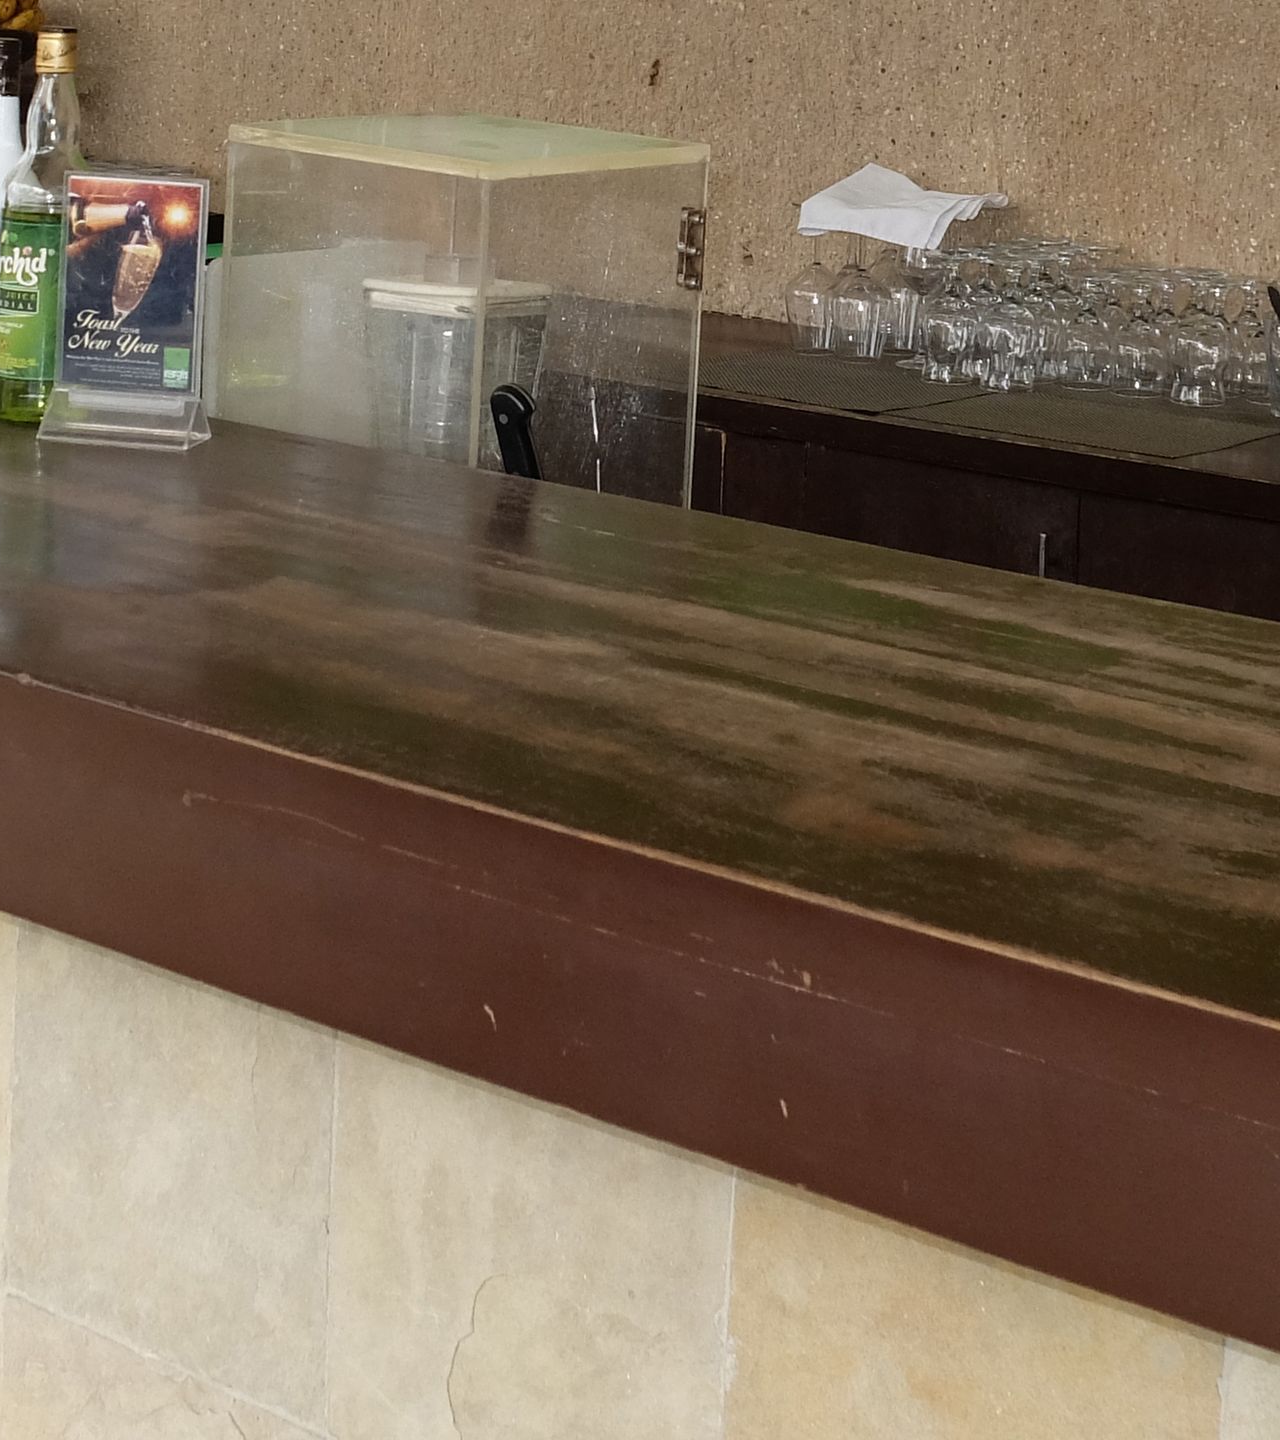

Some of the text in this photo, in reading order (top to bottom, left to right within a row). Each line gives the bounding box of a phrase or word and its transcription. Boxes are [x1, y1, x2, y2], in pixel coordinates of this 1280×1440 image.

[0, 246, 47, 287] rchid
[73, 308, 124, 332] Toast
[67, 330, 160, 358] New Year
